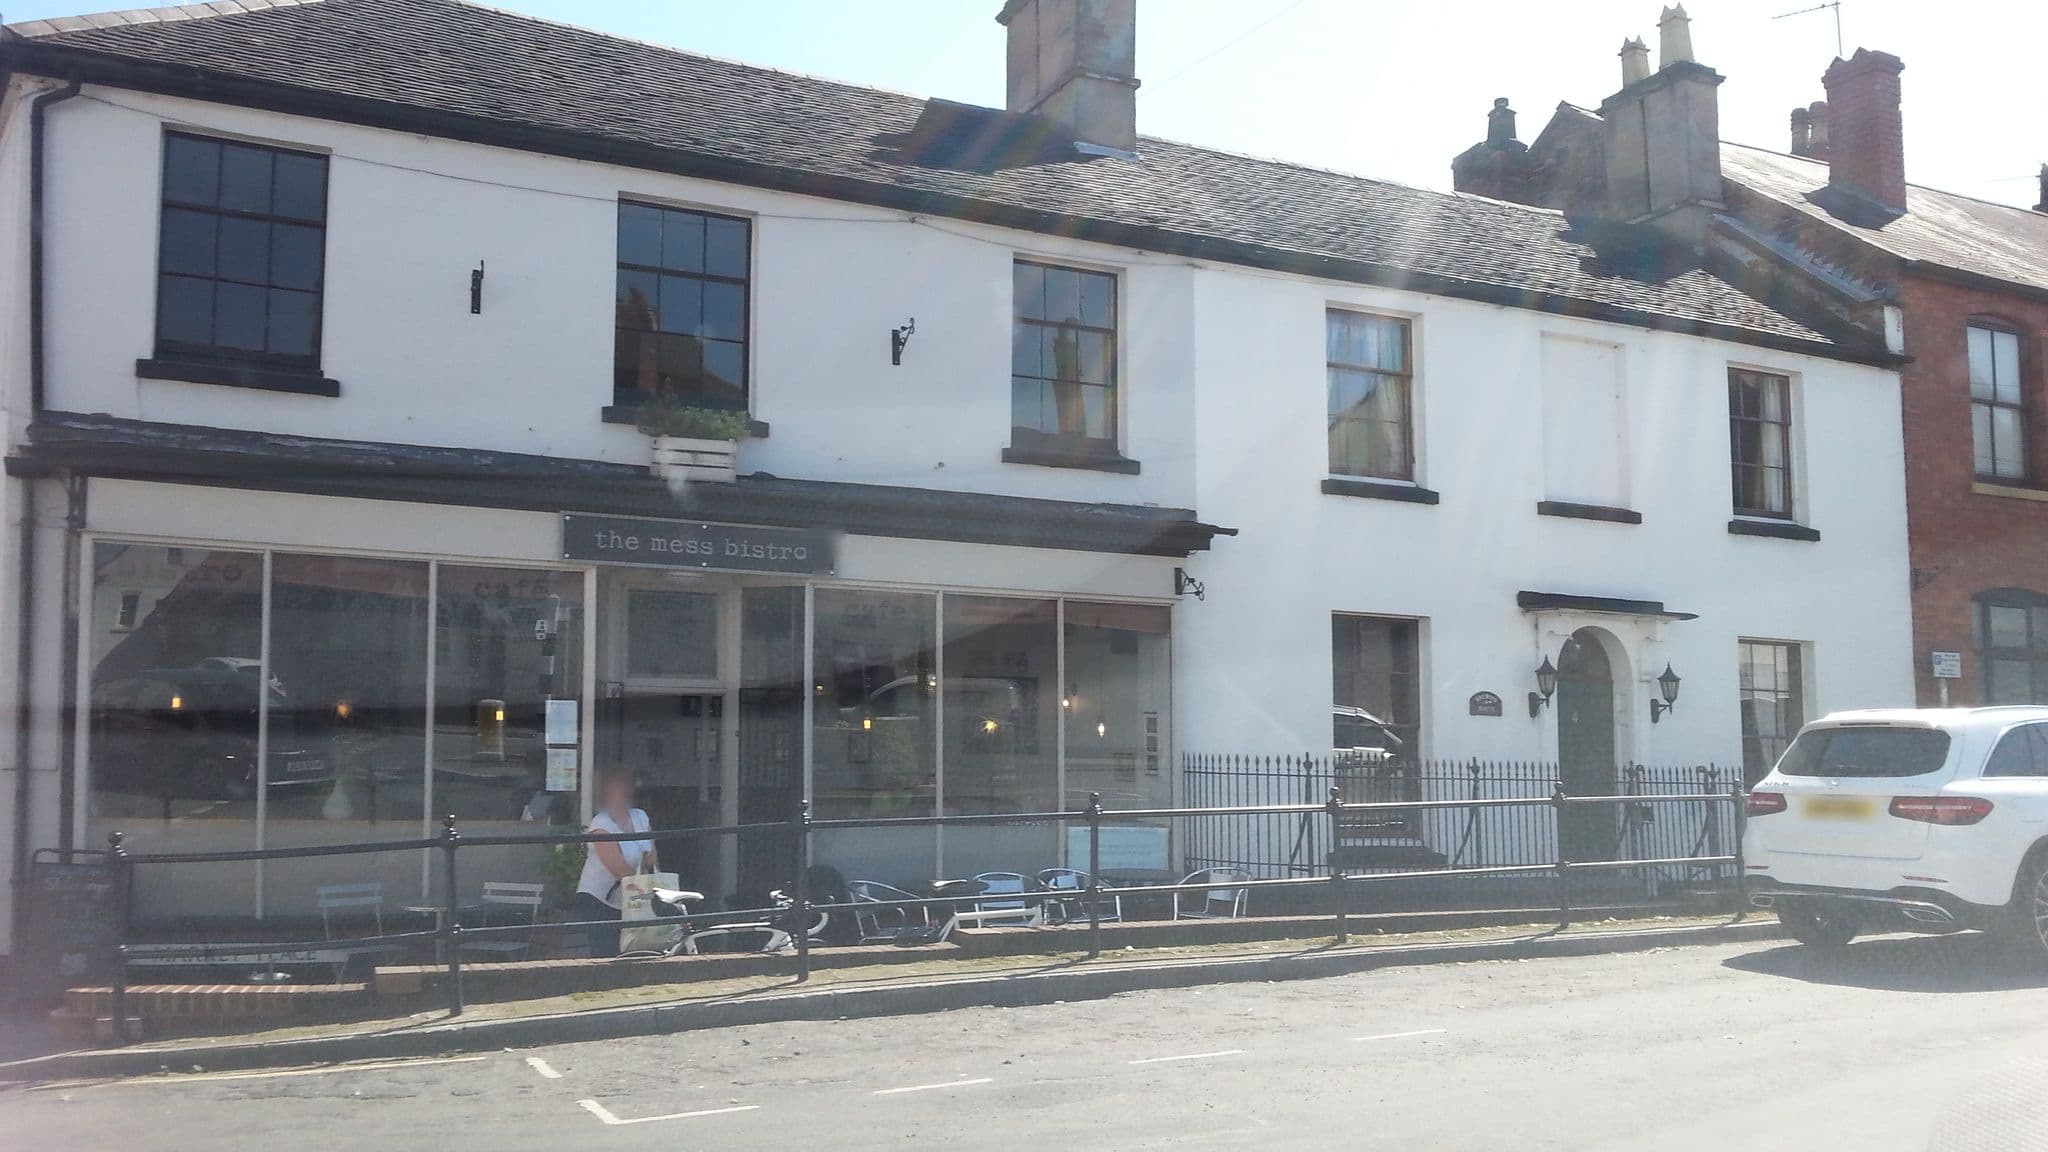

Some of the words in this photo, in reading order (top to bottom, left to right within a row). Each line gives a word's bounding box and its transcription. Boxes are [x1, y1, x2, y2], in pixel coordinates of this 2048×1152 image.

[594, 531, 640, 551] the
[650, 536, 714, 556] mess
[725, 538, 808, 561] bistro
